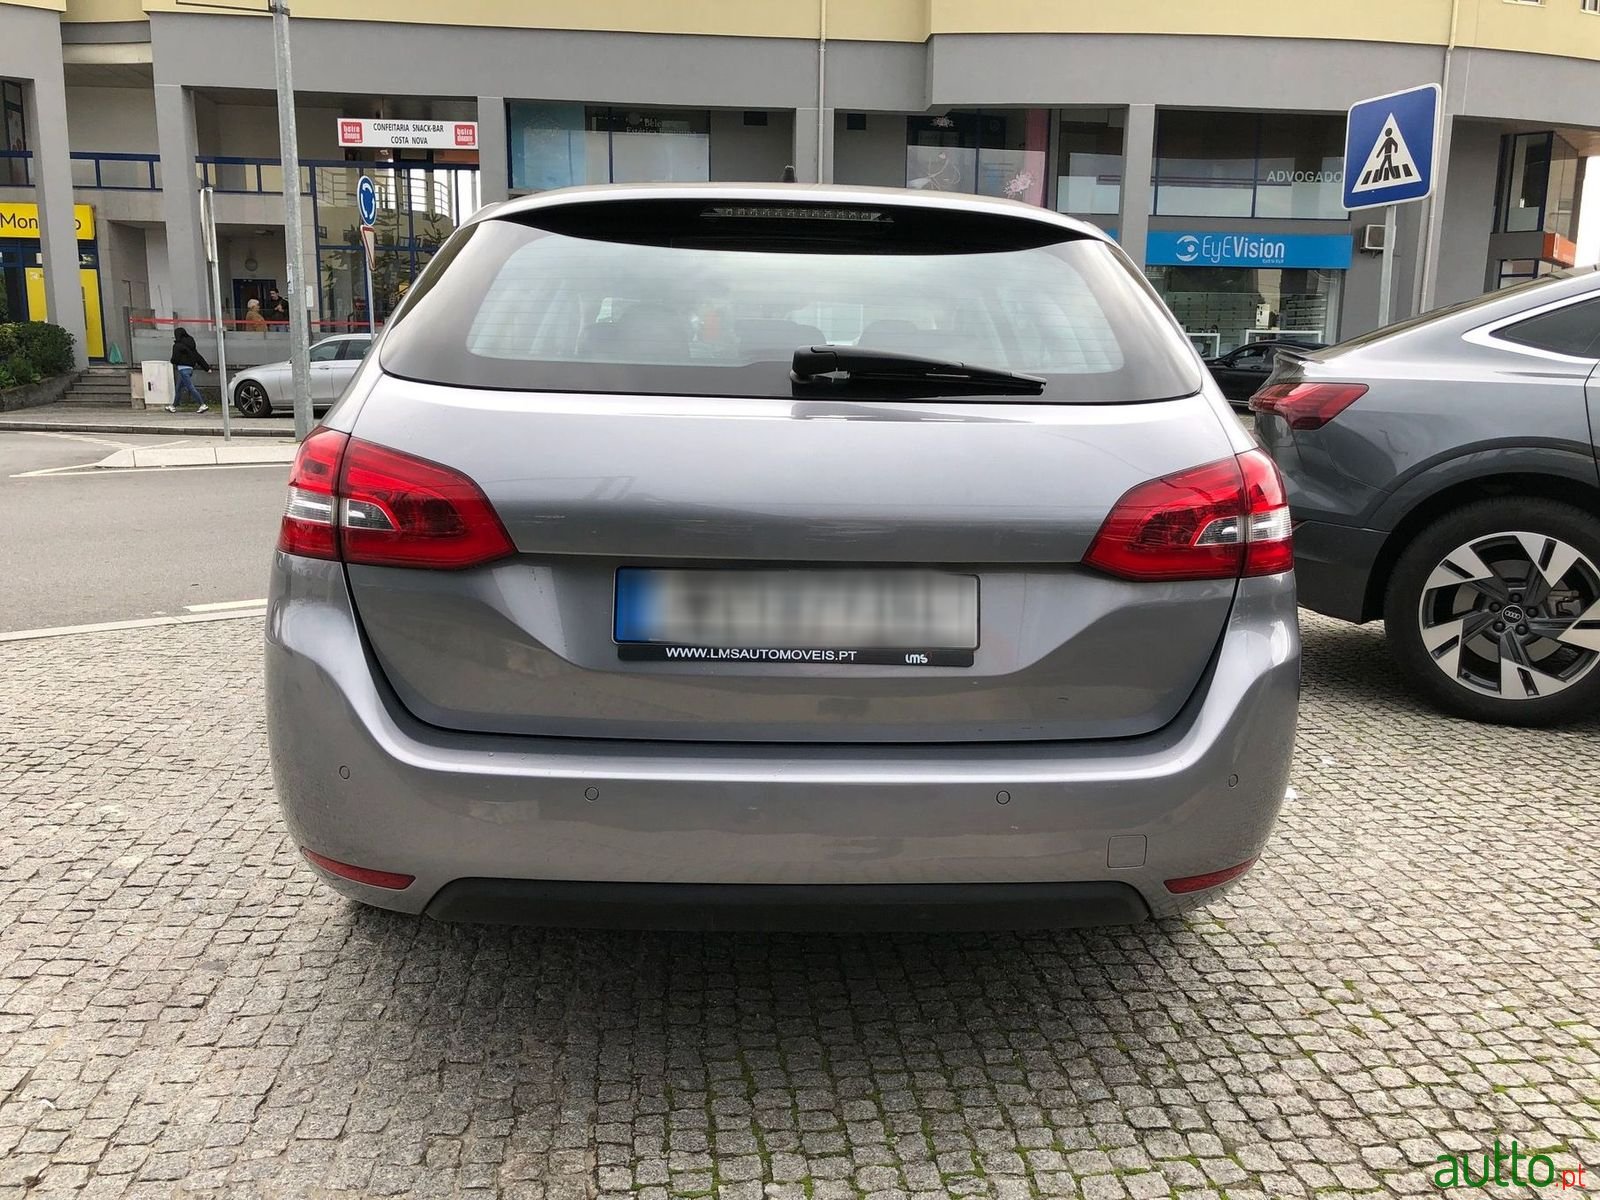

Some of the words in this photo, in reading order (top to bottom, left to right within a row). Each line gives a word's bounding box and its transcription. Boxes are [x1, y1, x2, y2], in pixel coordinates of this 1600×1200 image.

[373, 123, 409, 132] CONFEITARIA
[412, 124, 444, 132] SNACK-BAR
[390, 136, 409, 144] COSTA
[411, 136, 428, 145] NOVA
[665, 647, 857, 662] WWW.LMSAUTOMOVEIS.PT
